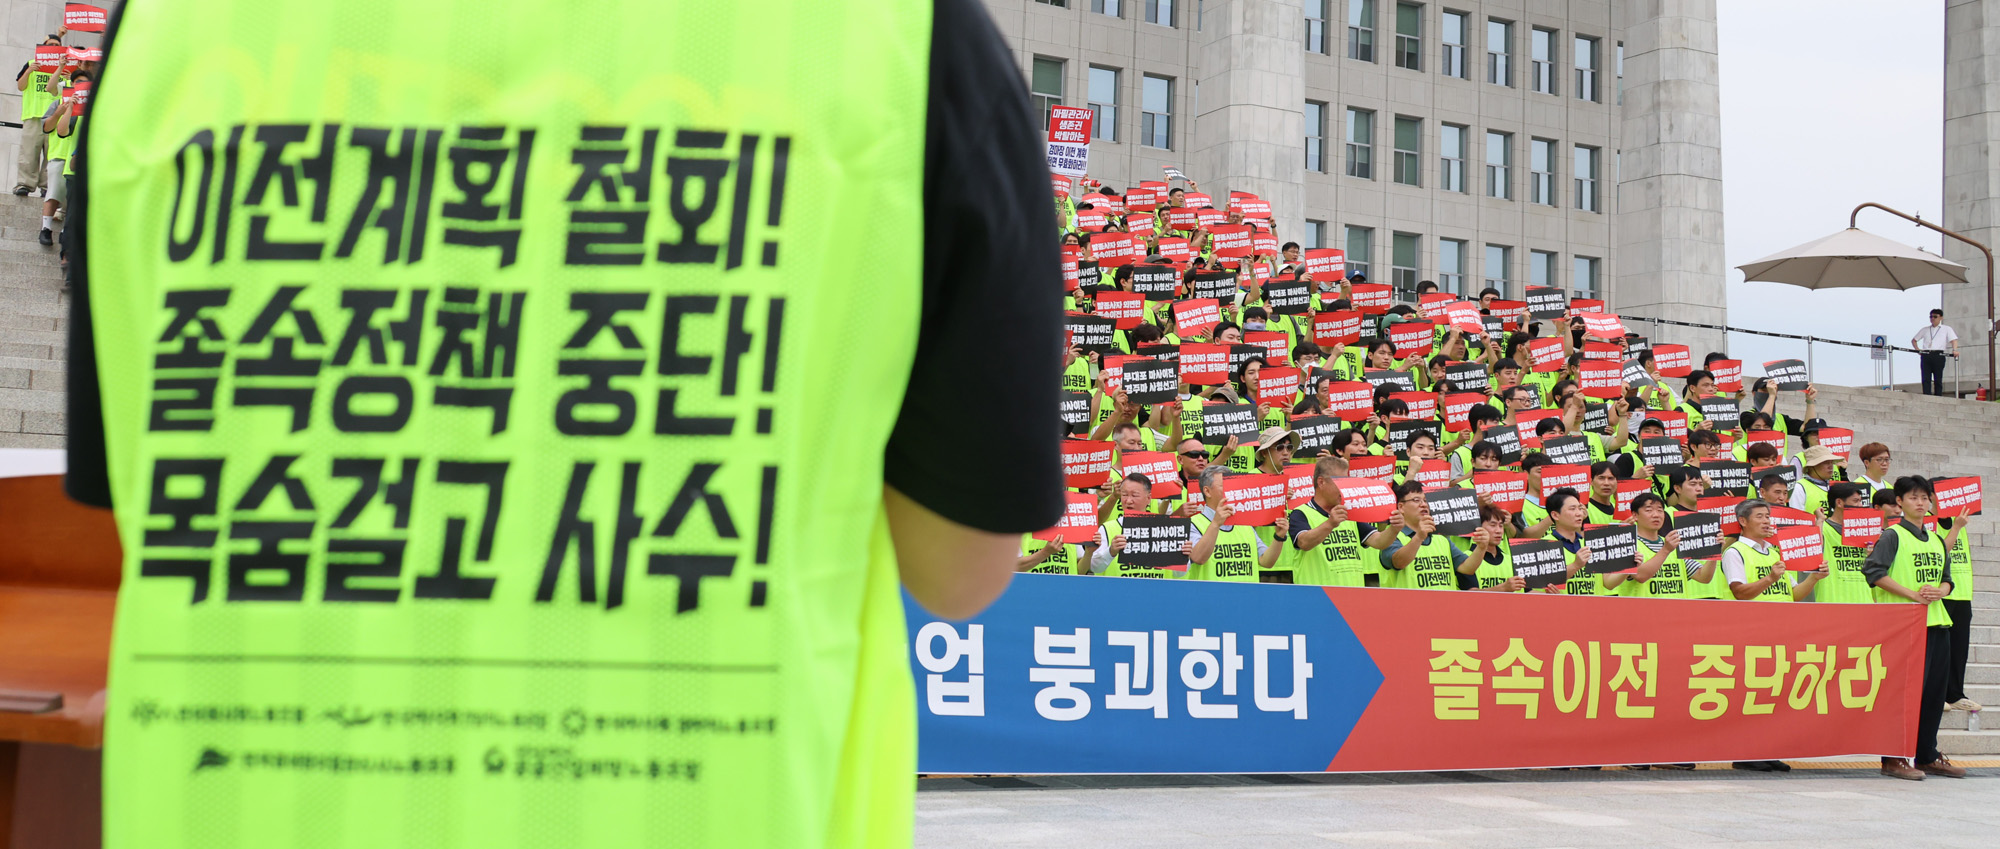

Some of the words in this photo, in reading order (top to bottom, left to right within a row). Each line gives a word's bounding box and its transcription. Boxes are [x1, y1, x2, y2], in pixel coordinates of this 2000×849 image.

[1053, 109, 1091, 119] 마필관리사
[1059, 120, 1083, 130] 생존권
[1054, 131, 1085, 141] 박탈하는
[1065, 147, 1076, 157] 이전
[1076, 148, 1087, 159] 계획
[166, 121, 536, 269] 이전계획
[561, 125, 793, 270] 철회!
[148, 286, 528, 436] 졸속정책
[554, 291, 787, 436] 중단!
[1207, 353, 1225, 361] 외면한
[1124, 371, 1147, 381] 무대포
[1149, 368, 1176, 379] 마사이전,
[1125, 383, 1148, 394] 경주마
[1149, 380, 1177, 392] 사형선고!
[1204, 414, 1224, 424] 무대포
[1225, 410, 1255, 421] 마사이전,
[1205, 426, 1227, 437] 경주마
[1228, 422, 1258, 434] 사형선고!
[1089, 450, 1110, 461] 외면한
[1643, 447, 1660, 455] 무대포
[1153, 460, 1173, 471] 외면한
[1570, 472, 1587, 483] 외면한
[1722, 468, 1749, 478] 마사이전,
[1475, 483, 1507, 494] 말종사자
[1508, 480, 1524, 490] 외면한
[1723, 479, 1749, 488] 사형선고!
[1224, 487, 1260, 501] 말종사자
[1261, 483, 1284, 496] 외면한
[1936, 488, 1963, 500] 말종사자
[1963, 484, 1979, 495] 외면한
[1068, 503, 1092, 514] 외면한
[1263, 495, 1286, 509] 멈춰라!
[1428, 500, 1449, 512] 무대포
[1450, 496, 1477, 508] 마사이전,
[1939, 497, 1965, 509] 졸속이전
[1070, 515, 1097, 526] 멈춰라!
[1432, 514, 1455, 526] 경주마
[1455, 509, 1480, 522] 사형선고!
[1844, 518, 1868, 528] 말종사자
[1869, 517, 1881, 526] 외면한
[140, 454, 512, 606] 목숨걸고
[536, 462, 778, 615] 사수!
[1123, 527, 1149, 539] 무대포
[1152, 525, 1188, 538] 마사이전,
[1606, 531, 1635, 547] 마사이전,
[1844, 527, 1868, 537] 졸속이전
[1123, 541, 1149, 554] 경주마
[1779, 537, 1805, 550] 말종사자
[1805, 533, 1821, 544] 외면한
[1214, 543, 1252, 559] 경마공원
[1512, 552, 1536, 566] 무대포
[1538, 548, 1564, 562] 마사이전,
[1608, 545, 1636, 560] 사형선고!
[1782, 549, 1807, 561] 졸속이전
[1215, 561, 1253, 577] 이전반대
[1515, 566, 1539, 578] 경주마
[1539, 561, 1566, 575] 사형선고!
[1650, 580, 1683, 595] 이전반대
[1029, 627, 1313, 721] 붕괴한다
[1428, 636, 1659, 722] 졸속이전
[1687, 641, 1889, 720] 중단하라
